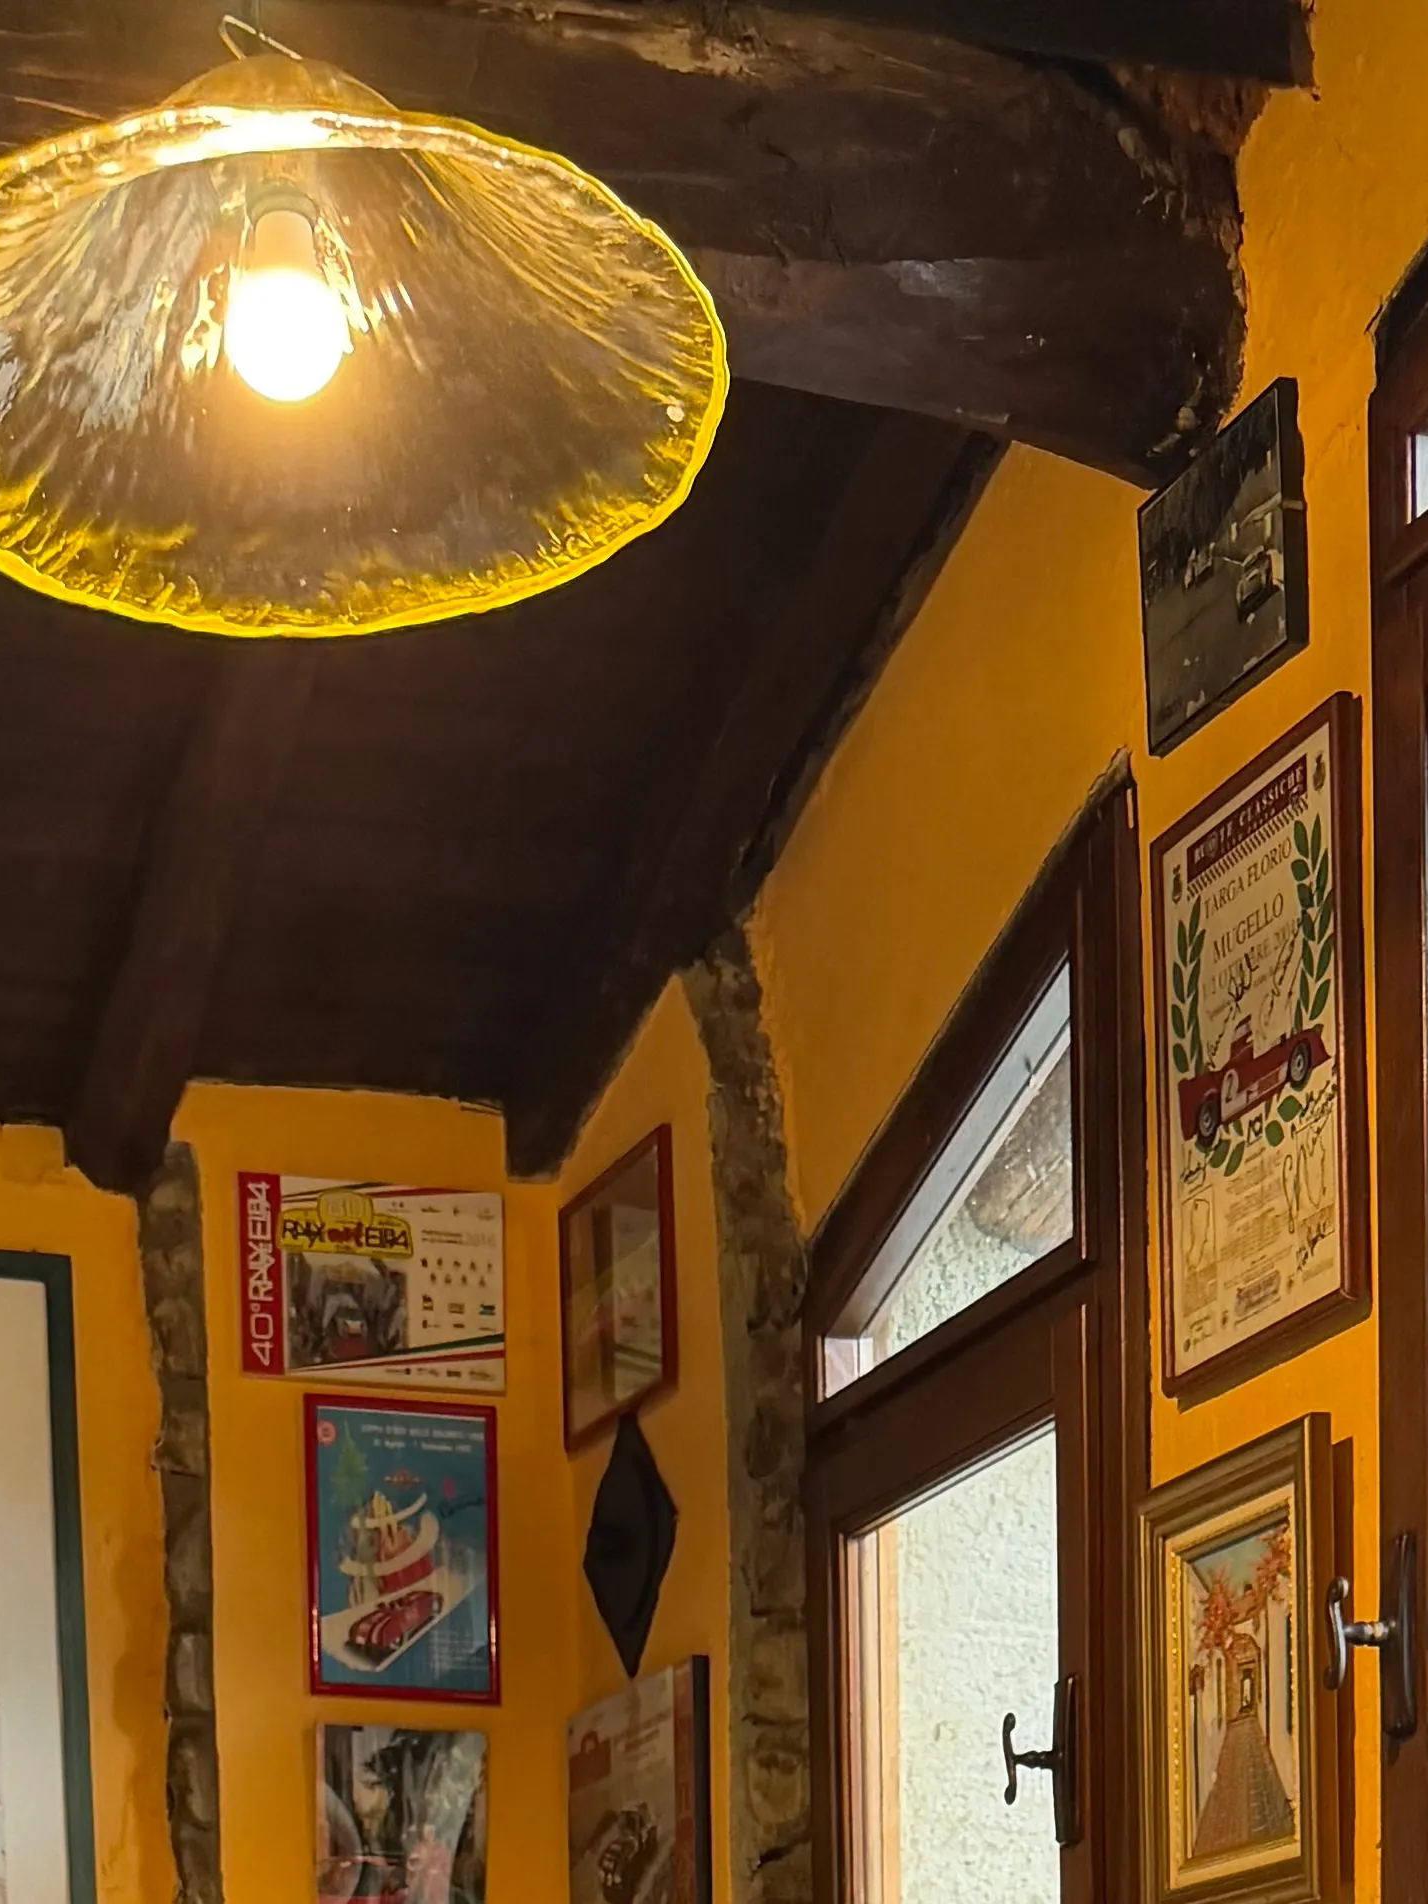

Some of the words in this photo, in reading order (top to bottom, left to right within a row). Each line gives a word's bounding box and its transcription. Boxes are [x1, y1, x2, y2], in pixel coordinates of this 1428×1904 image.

[1203, 877, 1245, 919] TARGA
[1247, 836, 1293, 887] FLORIO
[1213, 892, 1284, 964] MUGELLO
